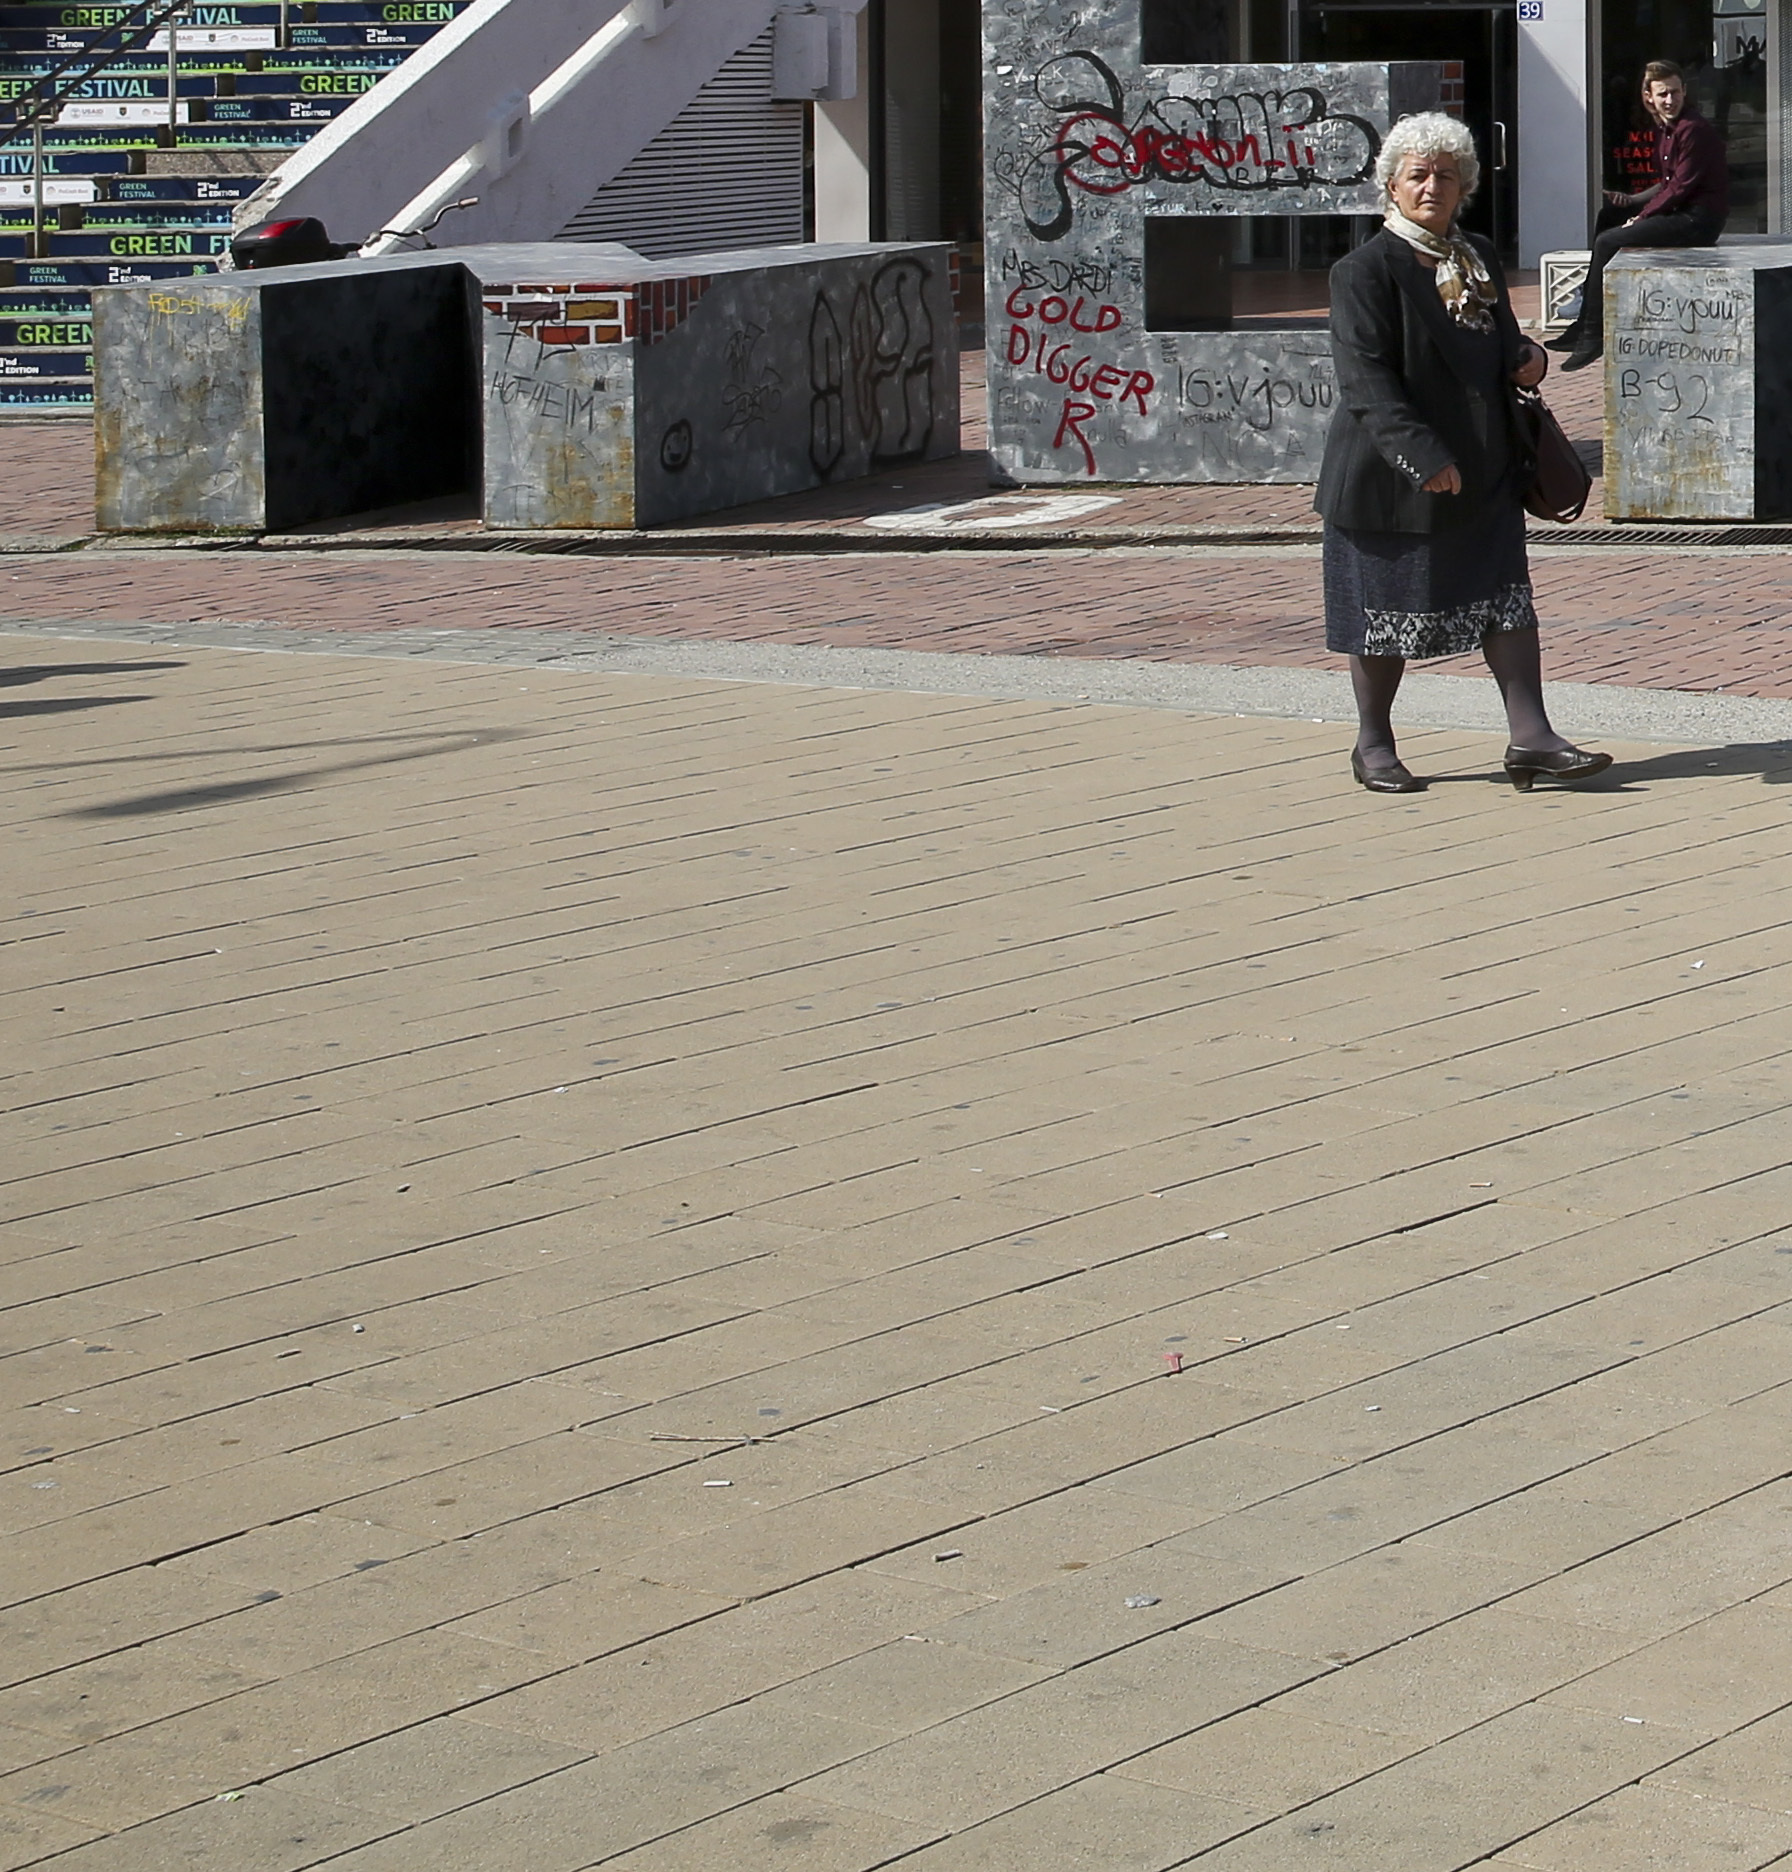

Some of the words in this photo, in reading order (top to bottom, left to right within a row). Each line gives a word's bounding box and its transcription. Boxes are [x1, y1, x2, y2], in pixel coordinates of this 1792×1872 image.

[61, 9, 130, 26] GREEN
[382, 3, 454, 20] GREEN
[1520, 2, 1541, 18] 39
[292, 36, 327, 44] FESTIVAL
[56, 80, 154, 98] FESTIVAL
[300, 75, 376, 92] GREEN
[120, 190, 156, 198] FESTIVAL
[208, 190, 239, 198] EDITION
[110, 235, 192, 255] GREEN
[30, 275, 67, 283] FESTIVAL
[1006, 284, 1122, 333] GOLD
[17, 324, 93, 344] GREEN
[5, 366, 39, 374] EDITION
[1007, 324, 1154, 417] DIGGER
[1053, 399, 1096, 476] R
